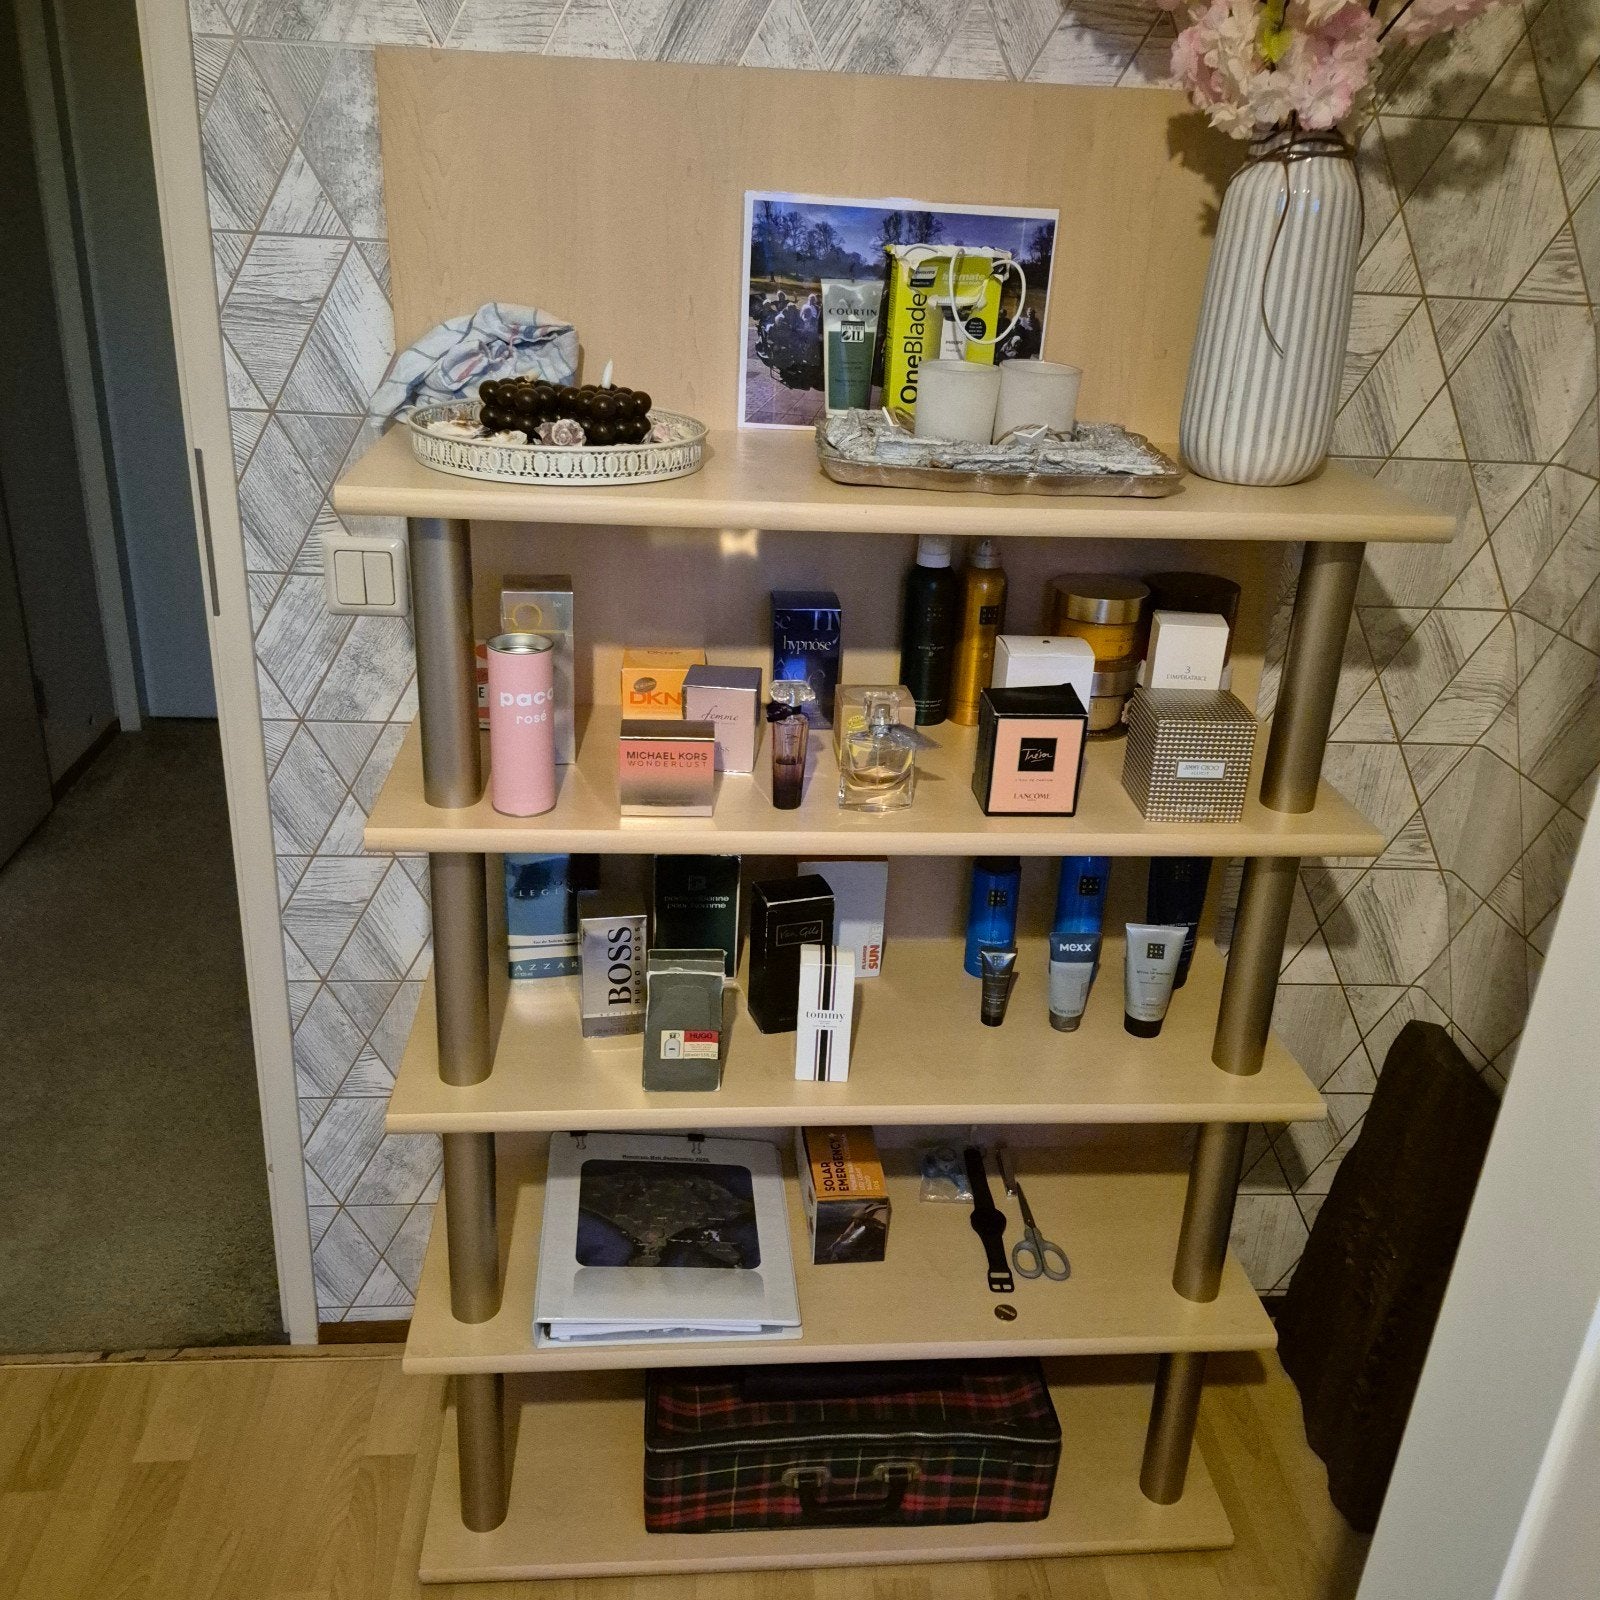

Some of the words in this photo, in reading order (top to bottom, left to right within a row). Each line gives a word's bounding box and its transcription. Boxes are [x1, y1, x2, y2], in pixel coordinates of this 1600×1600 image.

[900, 293, 928, 404] OneBlade
[1184, 665, 1191, 674] 3
[629, 690, 682, 706] DKN
[516, 709, 548, 725] rosé
[701, 704, 739, 721] femme
[626, 750, 675, 761] MICHAEL
[678, 751, 708, 761] KORS
[627, 760, 708, 769] WONDERLUST
[868, 944, 880, 970] SUN
[514, 961, 578, 972] AZZAR
[607, 926, 632, 1006] BOSS
[805, 1010, 846, 1023] tommy
[830, 1137, 849, 1191] EMERGENCY
[820, 1161, 836, 1192] SOLAR
